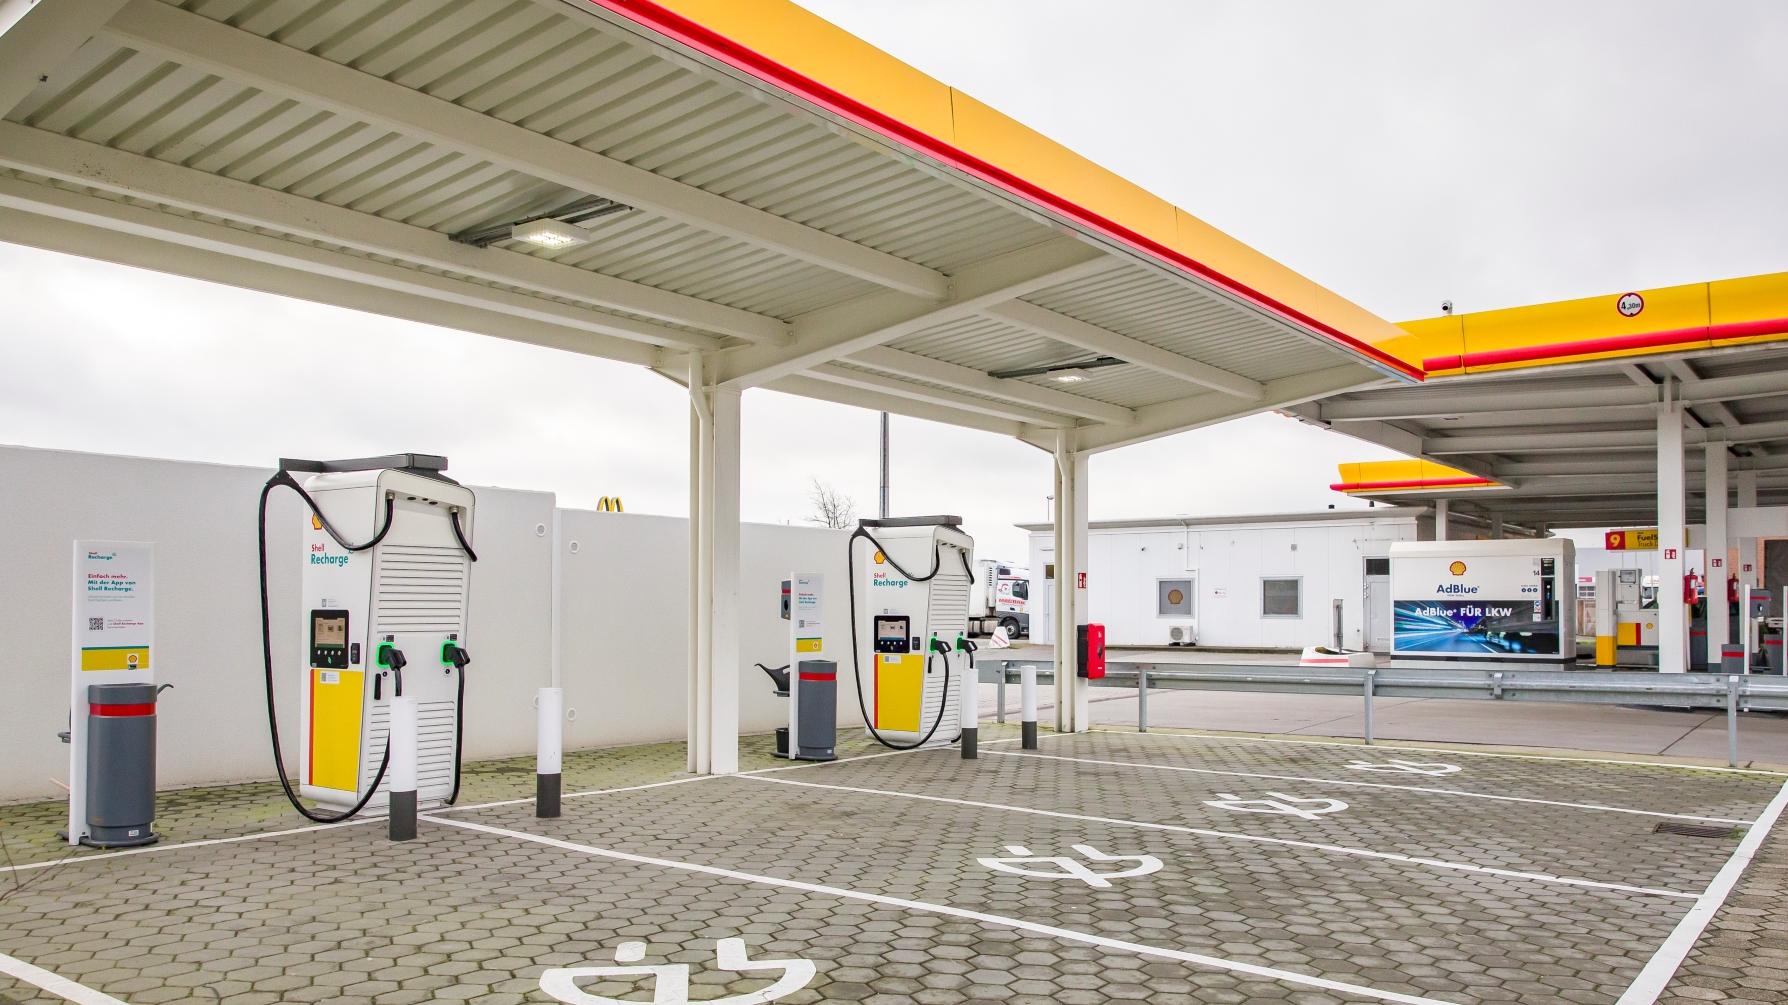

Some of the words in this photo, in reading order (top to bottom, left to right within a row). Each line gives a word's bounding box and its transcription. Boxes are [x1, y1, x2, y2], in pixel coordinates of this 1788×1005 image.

[1609, 534, 1621, 548] 9
[311, 543, 325, 552] Shell
[310, 552, 348, 567] Recharge
[873, 578, 908, 588] Recharge
[1460, 605, 1482, 617] FÜR
[1485, 607, 1513, 617] LKW
